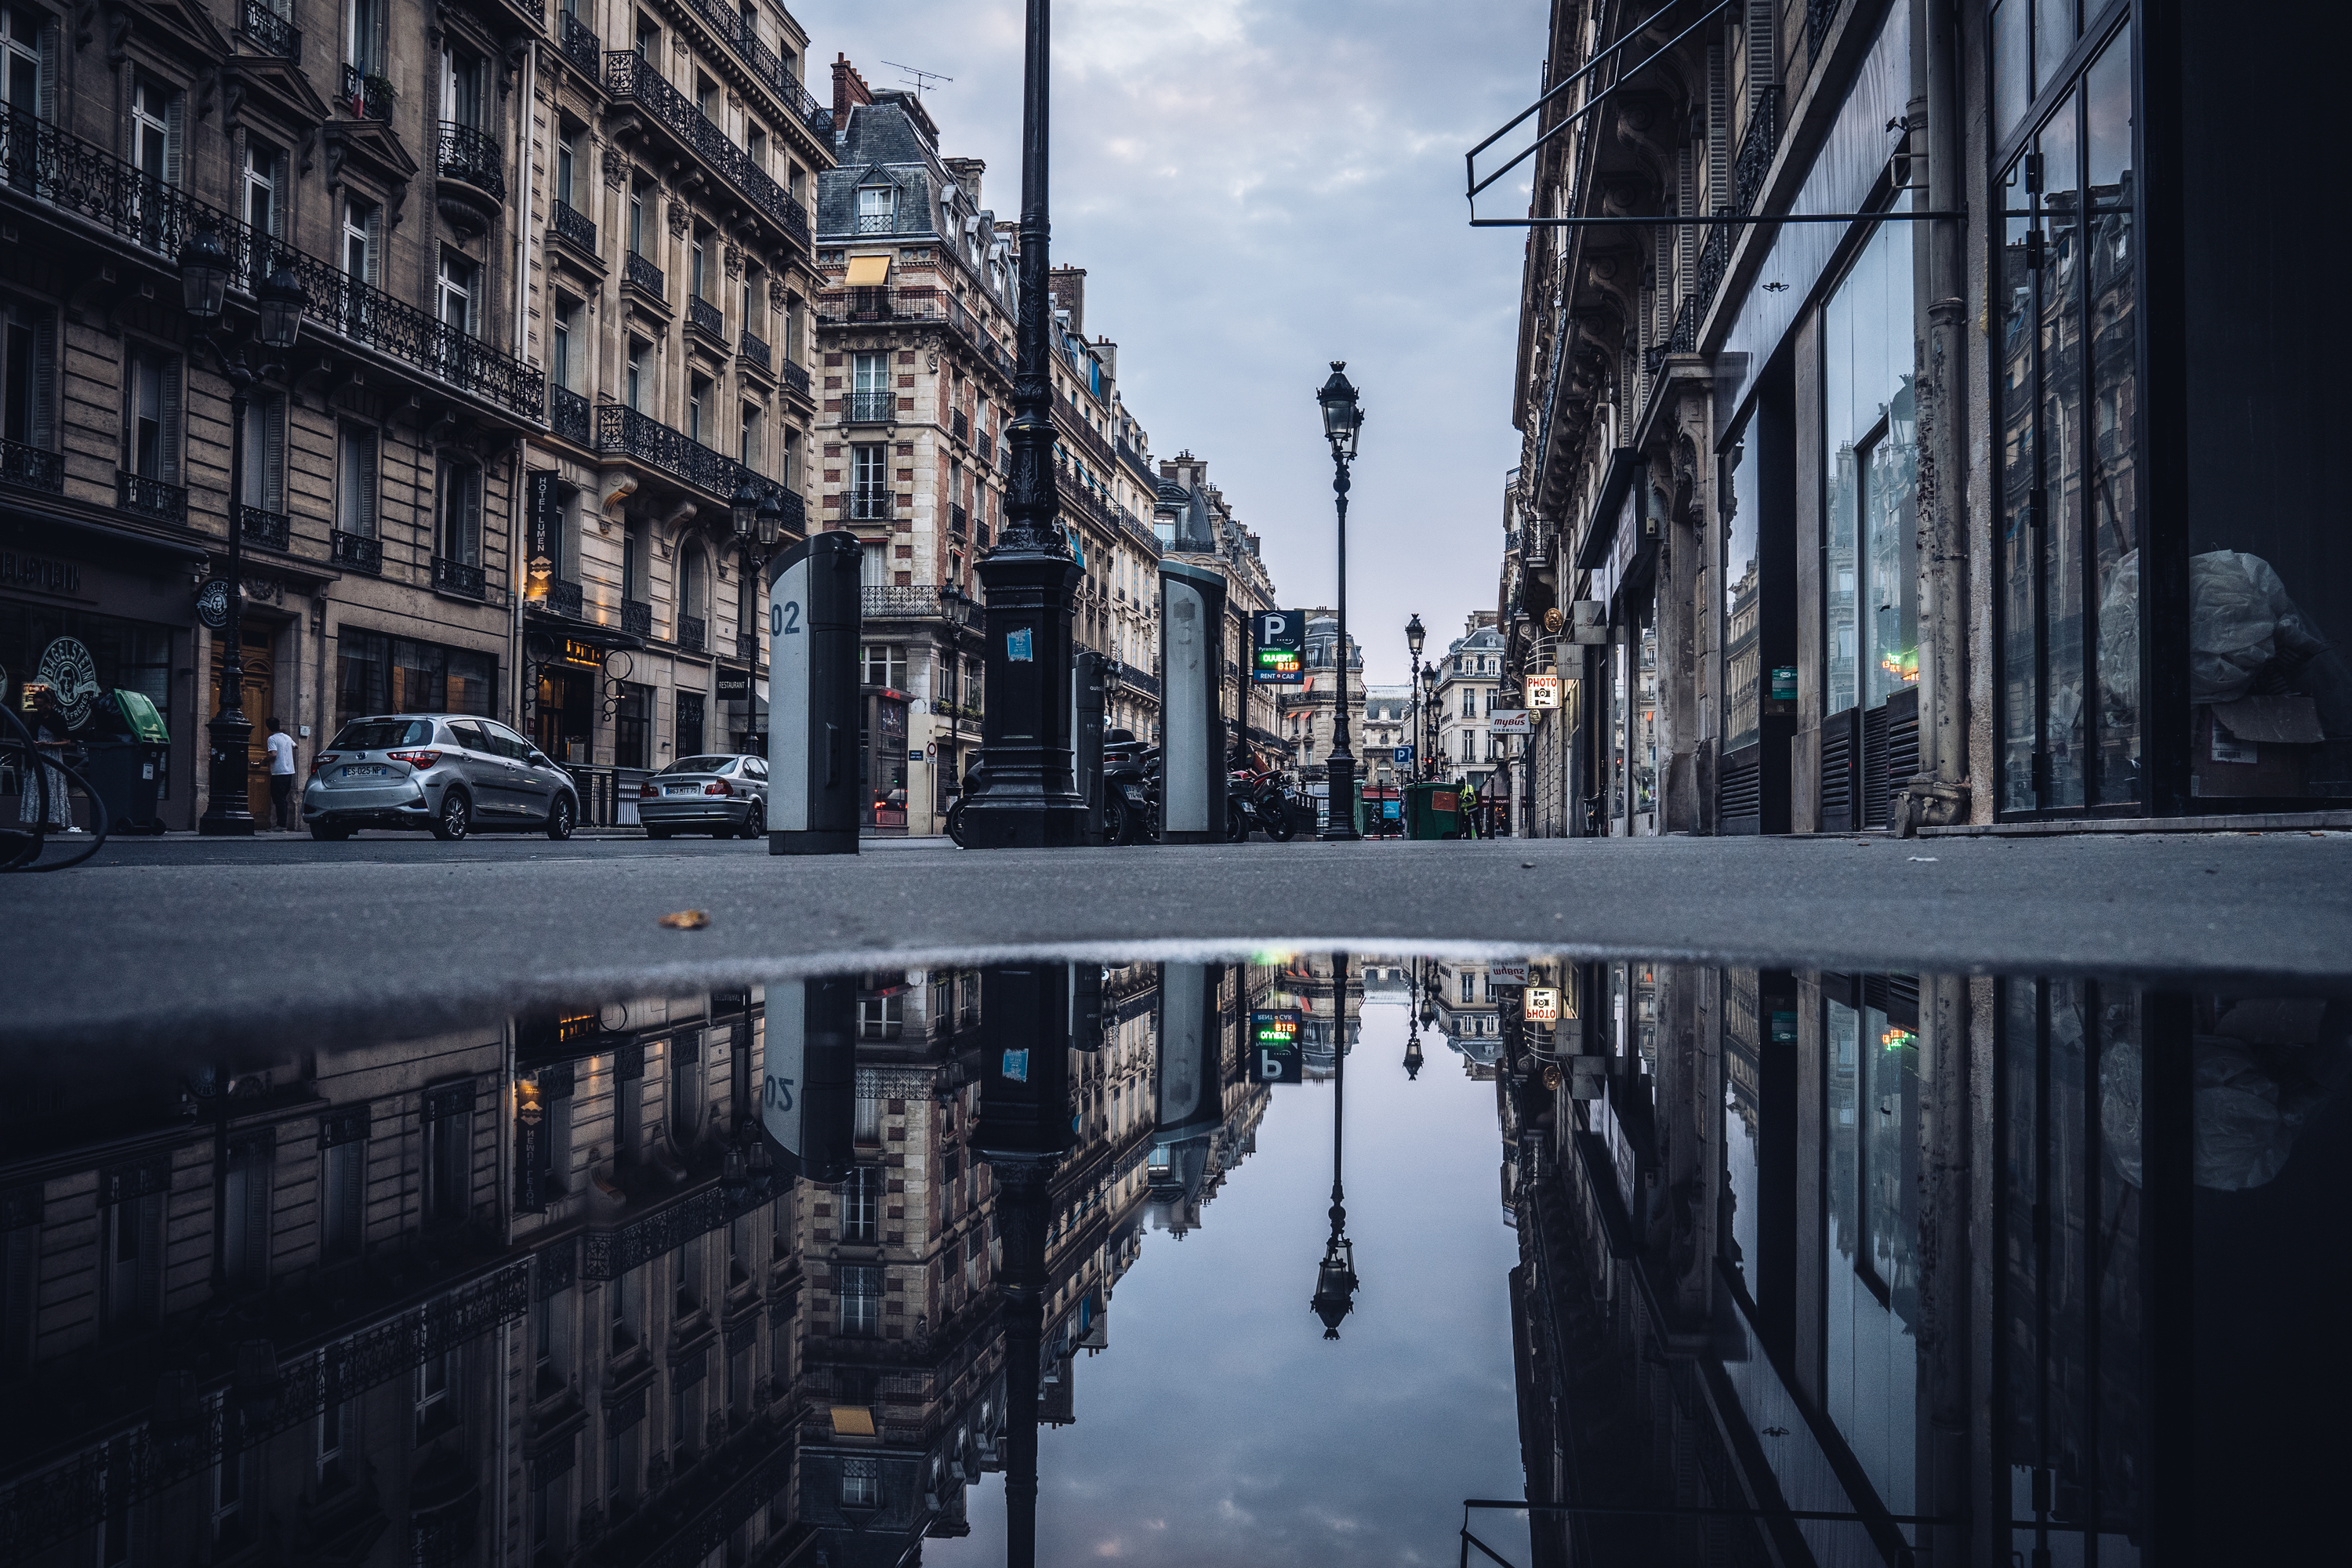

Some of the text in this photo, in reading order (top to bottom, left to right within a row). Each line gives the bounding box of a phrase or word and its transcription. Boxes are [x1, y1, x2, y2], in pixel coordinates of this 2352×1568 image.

[537, 477, 547, 552] HOTEL LUMEN
[202, 583, 228, 601] BAGELST
[771, 601, 800, 637] 02
[1265, 616, 1286, 644] P
[42, 641, 94, 682] BAGELSTEIN
[1262, 654, 1294, 662] OUVERT
[1528, 677, 1557, 688] PHOTO
[70, 693, 89, 720] FRÈRES
[1398, 750, 1406, 760] P
[347, 766, 382, 775] ES-025-NP
